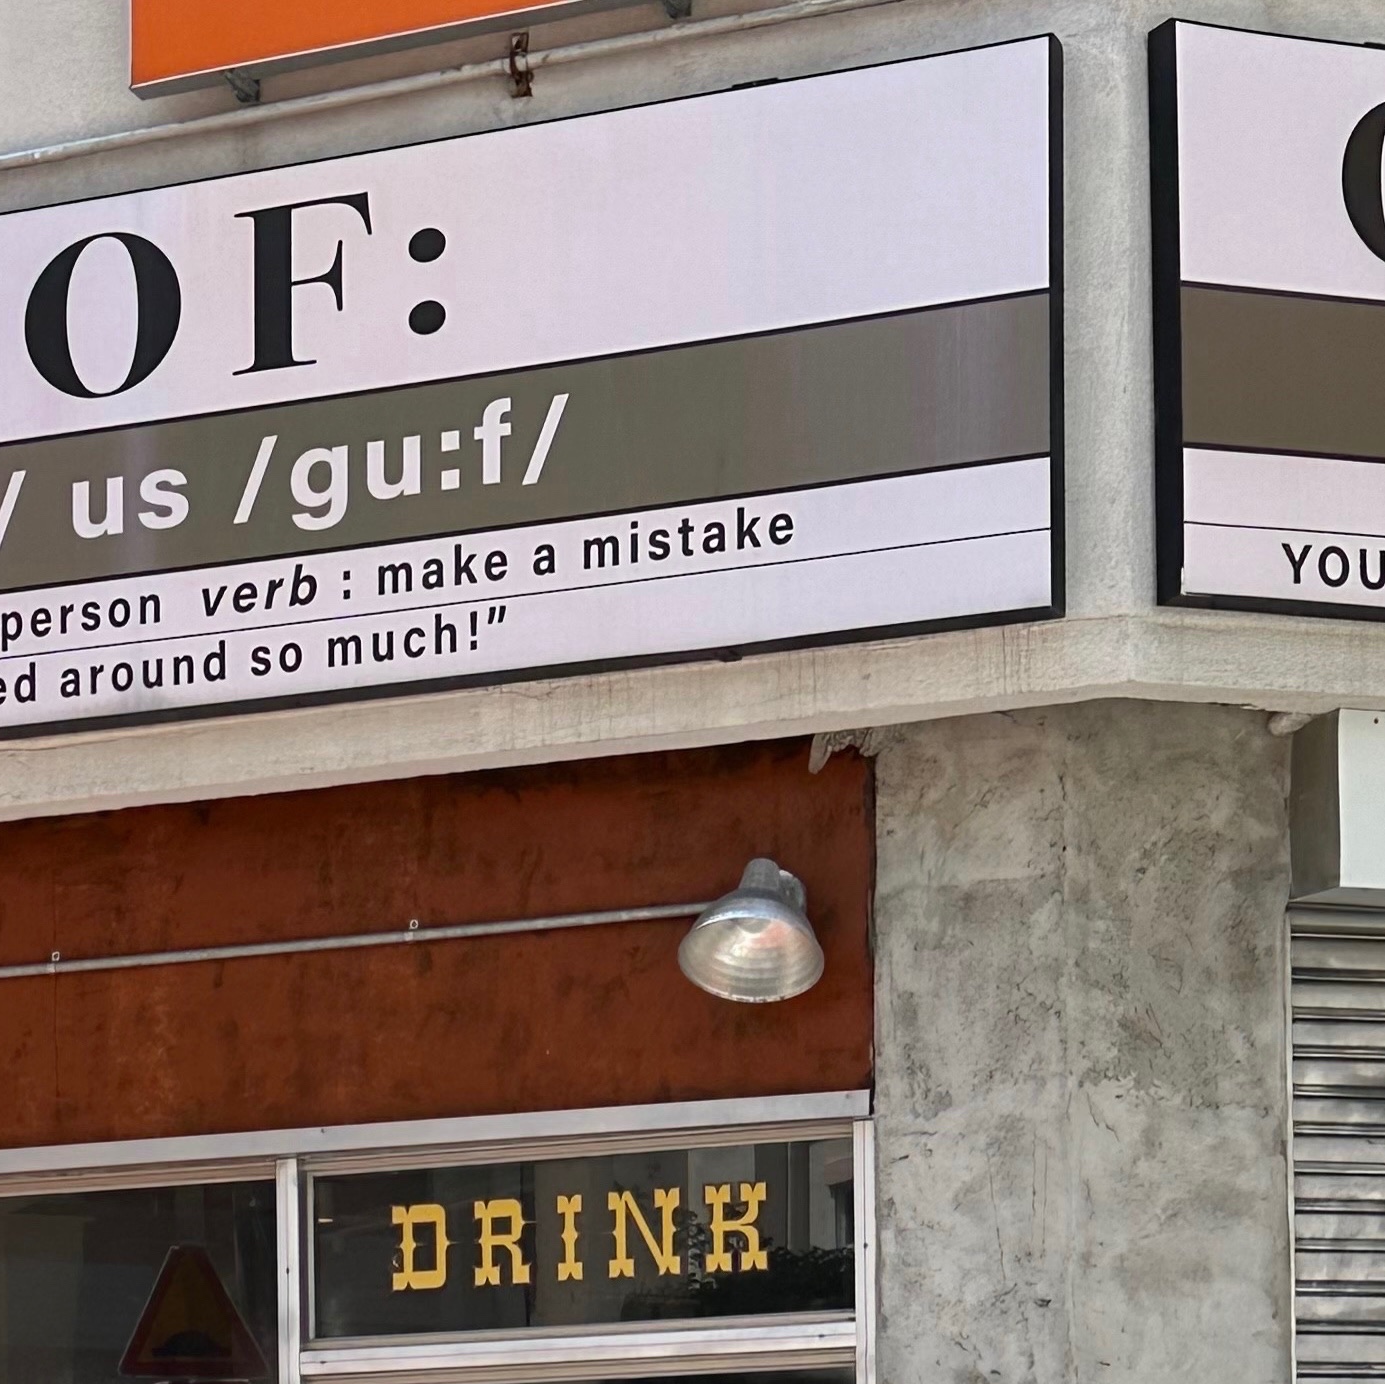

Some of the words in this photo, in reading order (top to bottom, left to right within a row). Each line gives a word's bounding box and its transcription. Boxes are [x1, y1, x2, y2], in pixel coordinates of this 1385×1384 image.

[73, 469, 188, 538] us
[234, 394, 569, 530] /gu:f/
[2, 594, 160, 651] person
[202, 564, 317, 616] verb
[379, 544, 507, 595] make
[533, 545, 555, 575] a
[584, 507, 793, 569] mistake
[61, 640, 225, 697] around
[251, 643, 302, 676] so
[391, 1182, 768, 1291] DRINK
